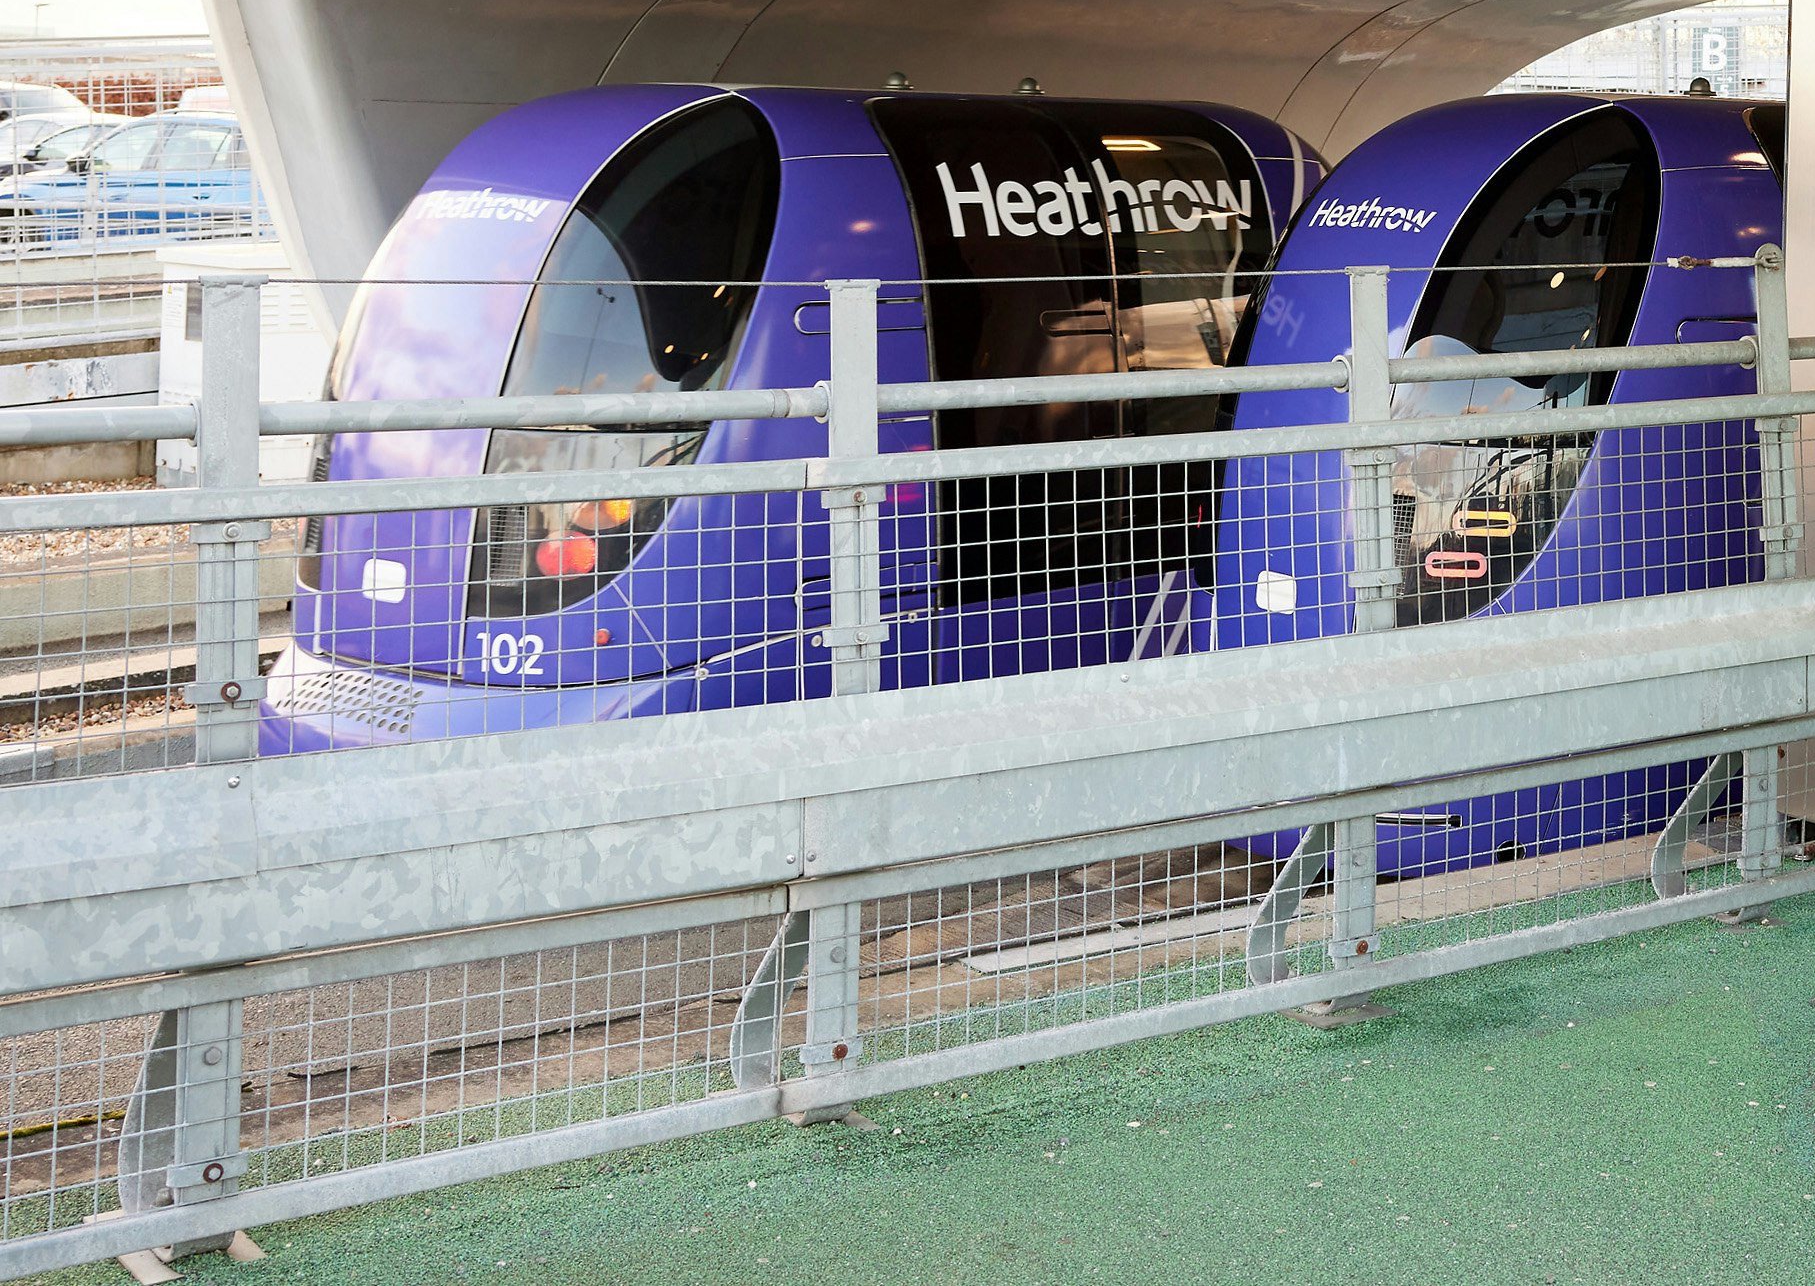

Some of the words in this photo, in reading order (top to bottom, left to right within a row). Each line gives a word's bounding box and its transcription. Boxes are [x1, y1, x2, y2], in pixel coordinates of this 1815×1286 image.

[1702, 33, 1727, 71] B
[415, 187, 551, 223] Heathrow
[935, 158, 1251, 238] Heathrow
[1308, 196, 1438, 233] Heathrow
[476, 632, 544, 675] 102
